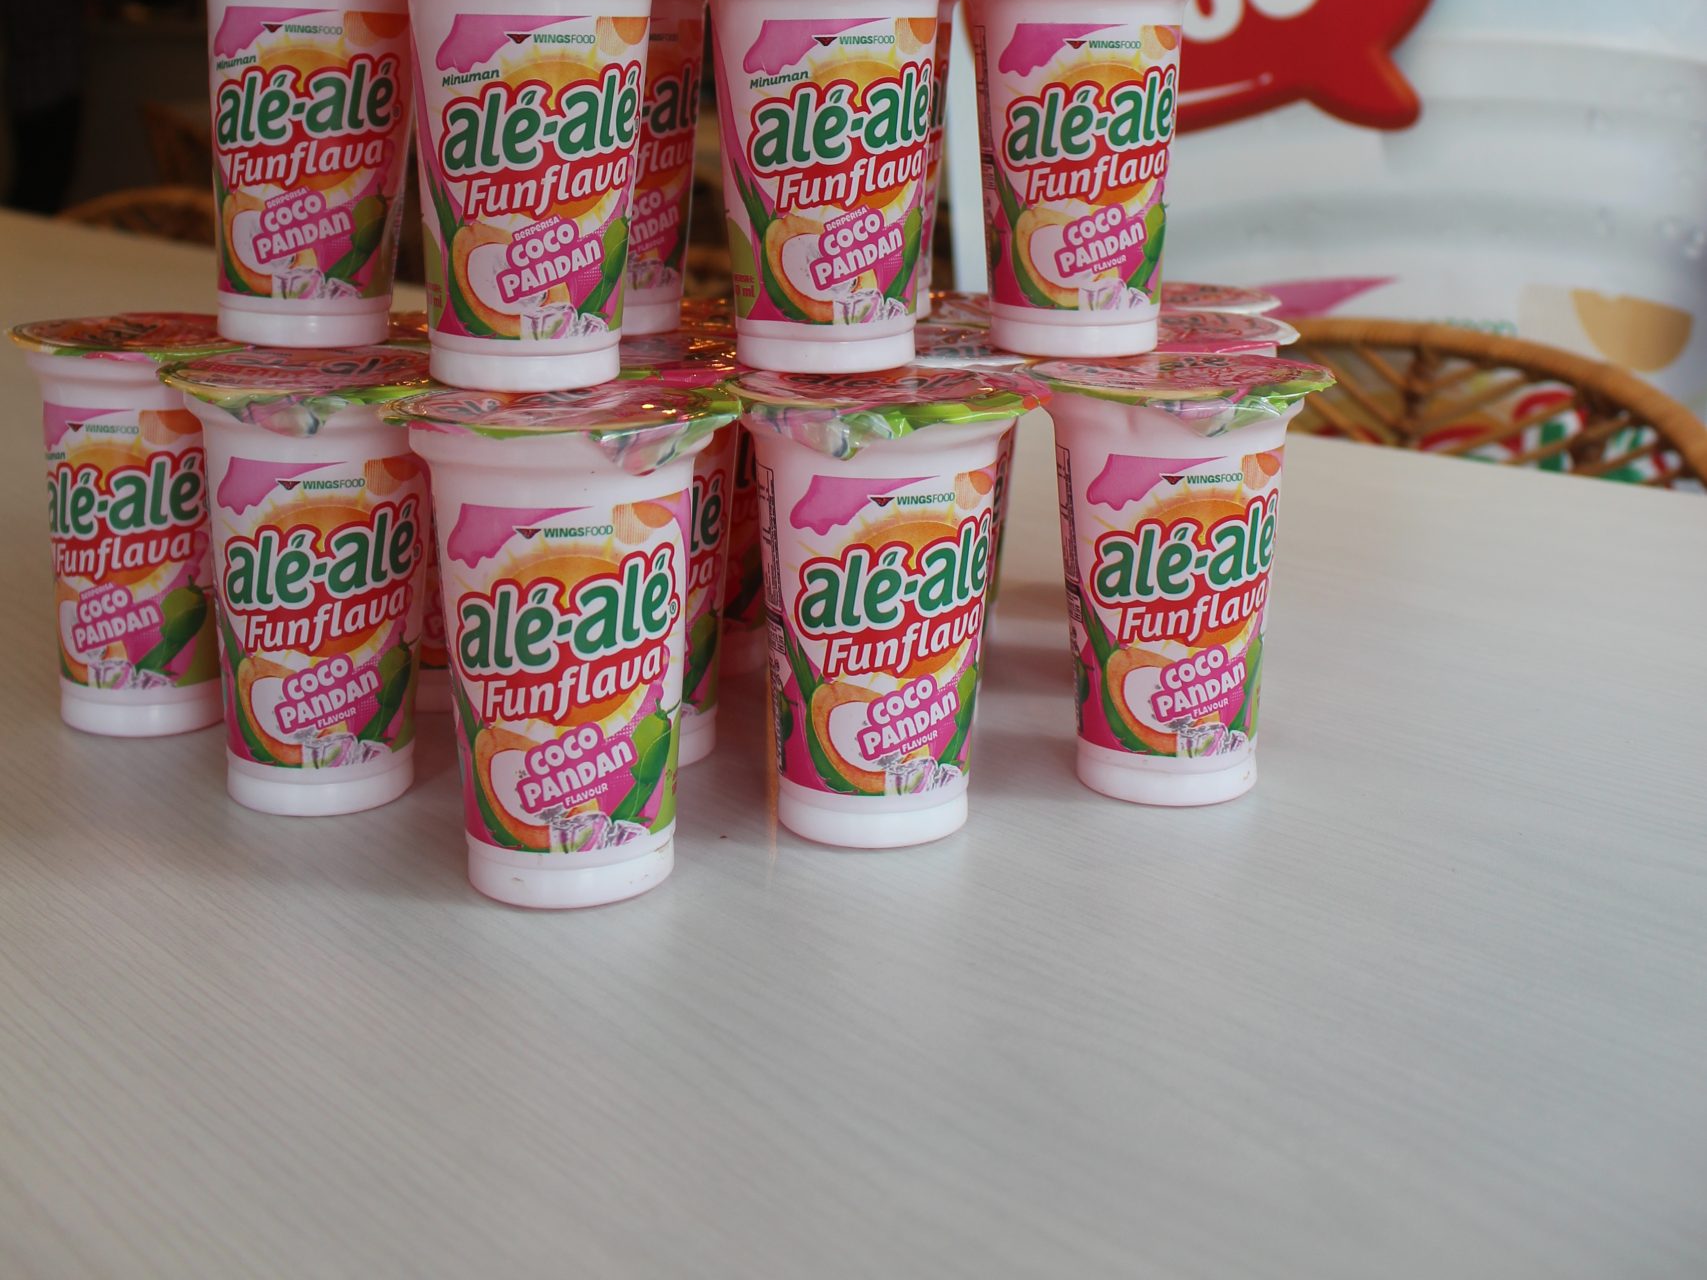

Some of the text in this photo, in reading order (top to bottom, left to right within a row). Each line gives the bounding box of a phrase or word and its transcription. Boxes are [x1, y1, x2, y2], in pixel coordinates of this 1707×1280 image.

[284, 24, 343, 35] WINGSFOOD
[533, 33, 595, 44] WINGSFOOD
[840, 35, 895, 44] WINGSFOOD
[1089, 40, 1141, 49] WINGSFOOD
[216, 54, 256, 70] Minuman
[442, 69, 500, 87] Minuman
[750, 71, 808, 88] Minuman
[217, 62, 394, 145] alé-alé
[445, 71, 637, 170] alé-alé
[753, 70, 928, 168] alé-alé
[1008, 73, 1173, 161] alé-alé
[231, 140, 383, 186] Funflava
[468, 156, 628, 215] Funflava
[780, 155, 922, 209] Funflava
[1029, 149, 1166, 201] Funflava
[257, 212, 350, 259] PANDAN
[264, 195, 321, 232] COCO
[824, 217, 880, 256] COCO
[1068, 208, 1121, 246] COCO
[501, 239, 601, 297] PANDAN
[511, 224, 574, 266] COCO
[815, 228, 902, 285] PANDAN
[1059, 223, 1144, 273] PANDAN
[1094, 255, 1126, 272] FLAVOUR
[85, 424, 139, 434] WINGSFOOD
[303, 479, 365, 489] WINGSFOOD
[897, 492, 955, 505] WINGSFOOD
[1187, 473, 1242, 483] WINGSFOOD
[228, 504, 414, 604] alé-alé
[544, 525, 613, 538] WINGSFOOD
[1097, 499, 1275, 597] alé-alé
[57, 532, 191, 580] Funflava
[802, 519, 989, 628] alé-alé
[76, 606, 159, 649] PANDAN
[80, 591, 128, 623] COCO
[249, 587, 407, 649] Funflava
[461, 555, 670, 669] alé-alé
[1122, 584, 1266, 640] Funflava
[827, 616, 979, 673] Funflava
[287, 659, 348, 700] COCO
[485, 645, 661, 719] Funflava
[1157, 663, 1245, 717] PANDAN
[1165, 650, 1223, 688] COCO
[280, 671, 378, 728] PANDAN
[317, 706, 356, 728] FLAVOUR
[872, 679, 933, 725] COCO
[1193, 698, 1228, 717] FLAVOUR
[865, 693, 957, 754] PANDAN
[902, 730, 938, 752] FLAVOUR
[523, 740, 632, 808] PANDAN
[532, 727, 598, 776] COCO
[564, 783, 608, 807] FLAVOUR
